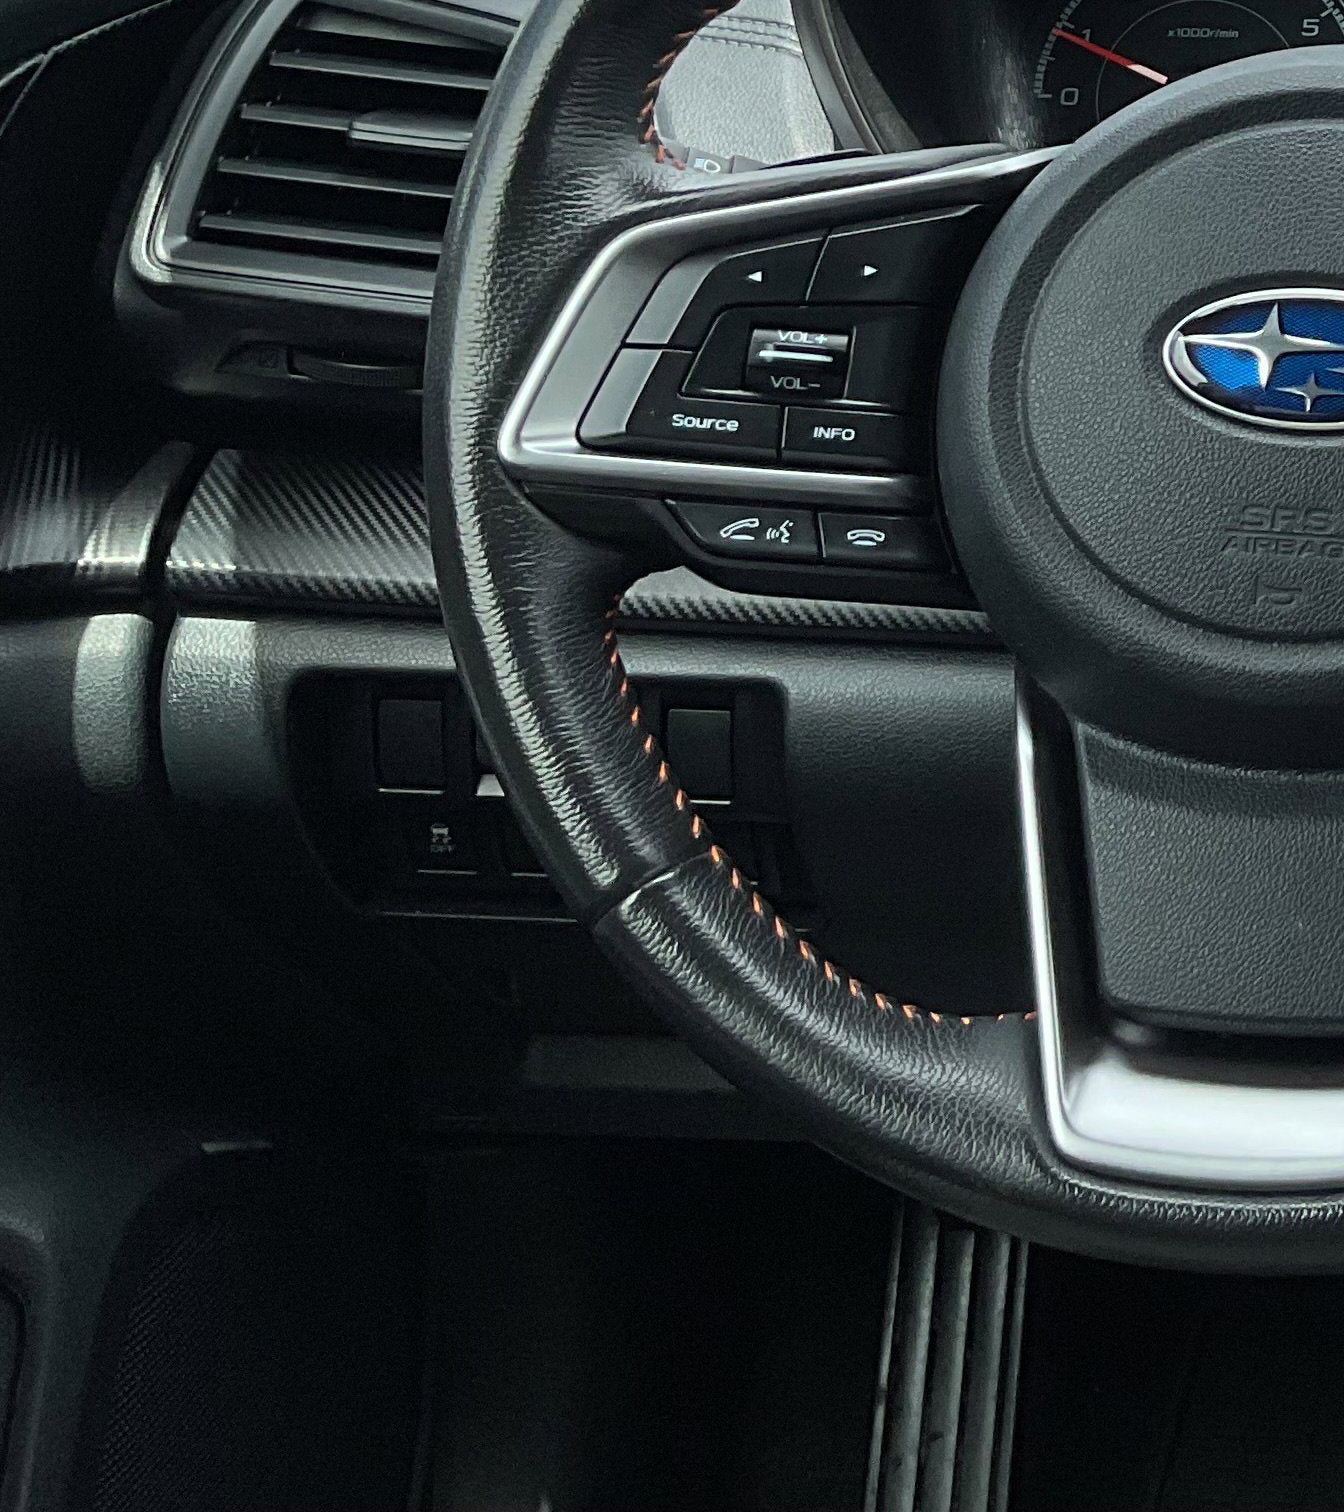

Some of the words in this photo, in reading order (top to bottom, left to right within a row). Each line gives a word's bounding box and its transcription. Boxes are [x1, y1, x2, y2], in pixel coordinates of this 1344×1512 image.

[1301, 18, 1320, 37] 5
[1060, 88, 1079, 106] 0
[671, 413, 740, 432] Source
[813, 426, 856, 441] INFO
